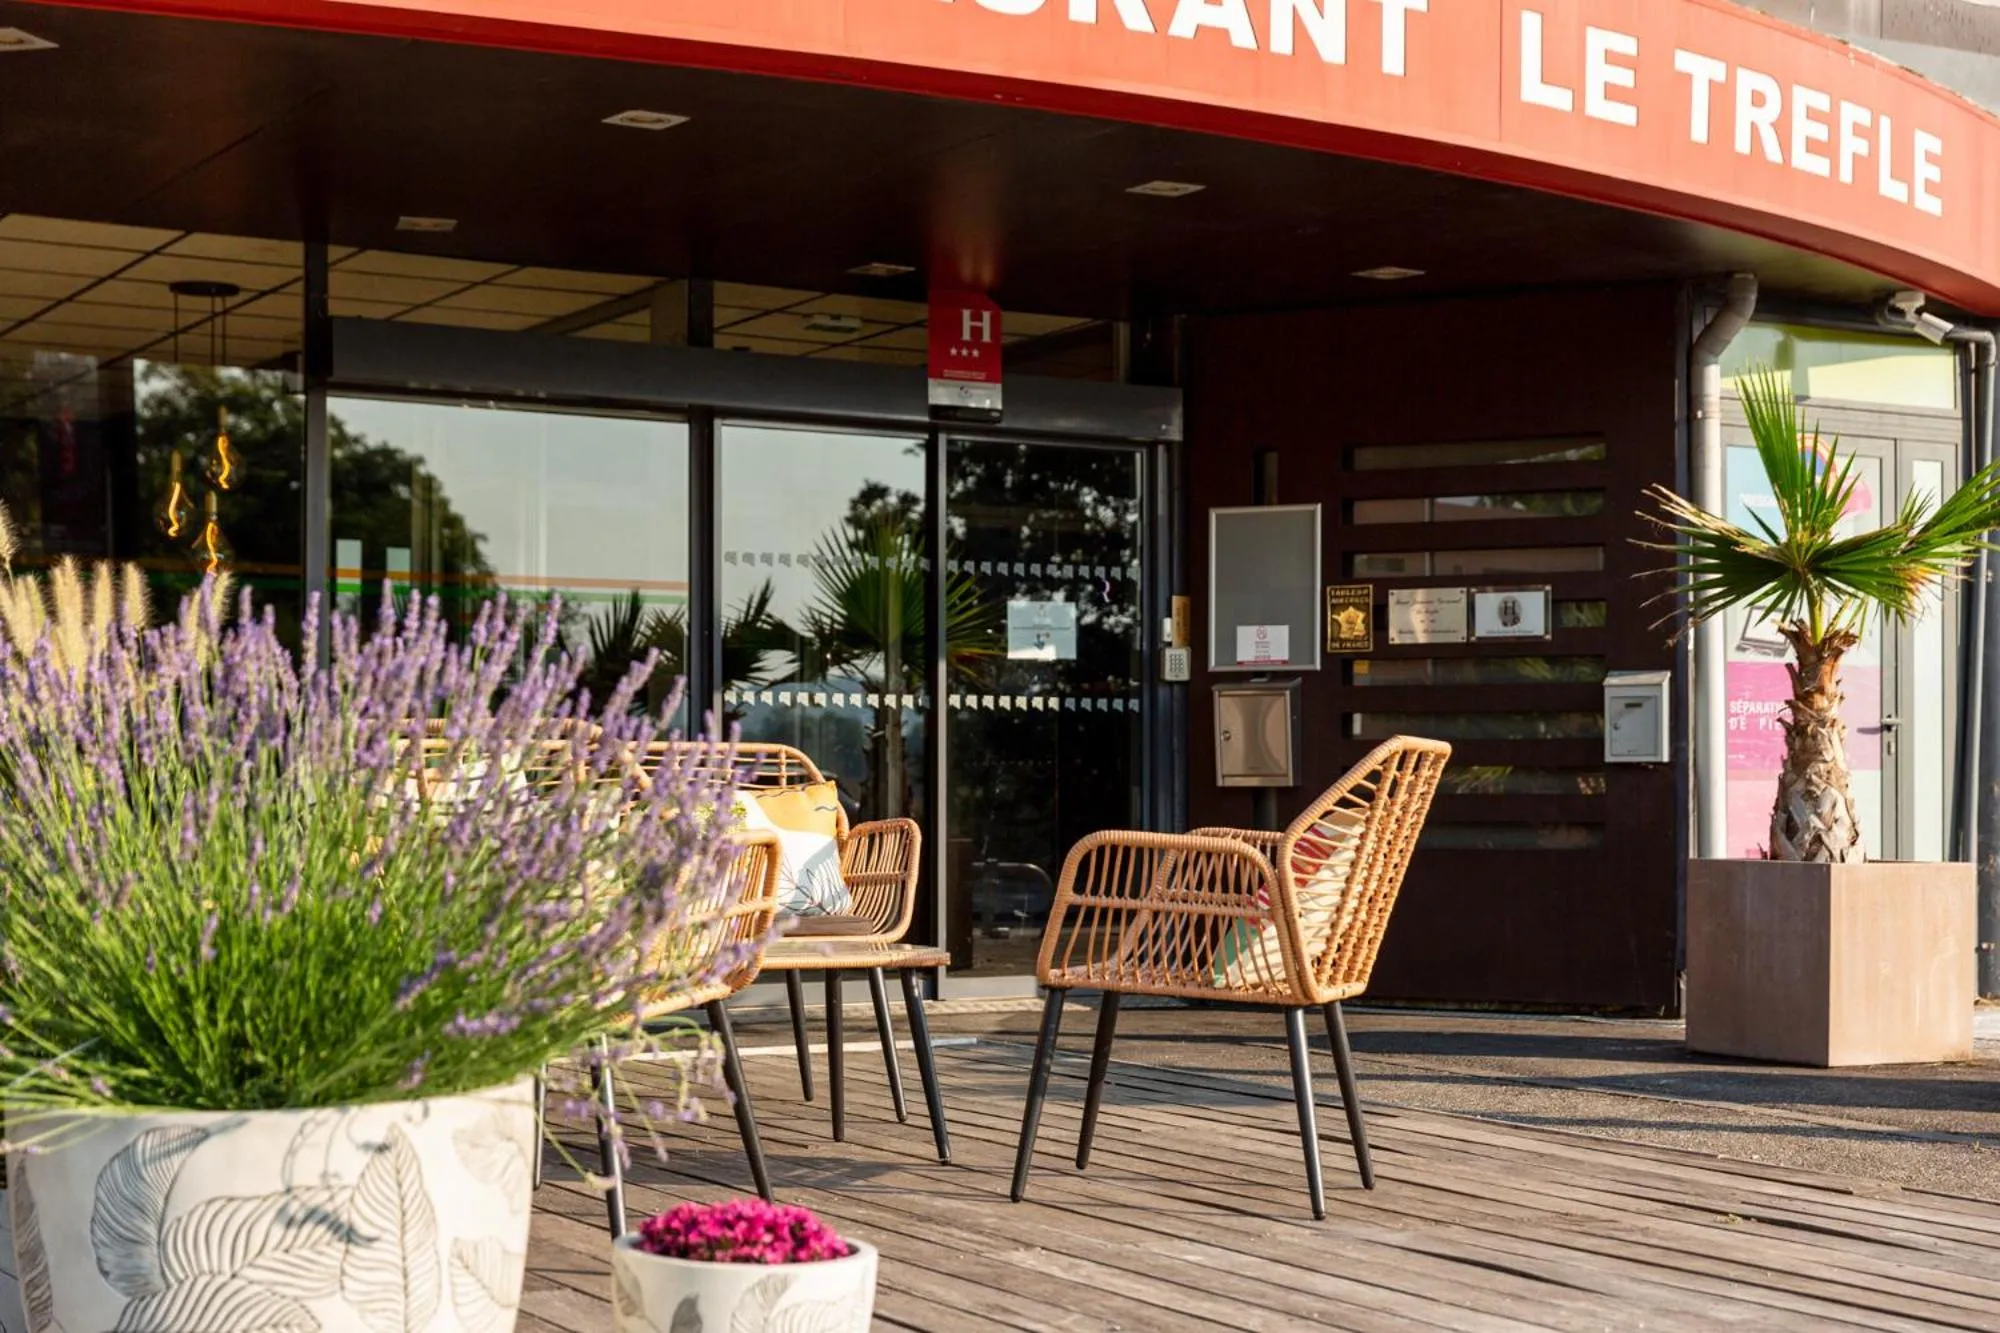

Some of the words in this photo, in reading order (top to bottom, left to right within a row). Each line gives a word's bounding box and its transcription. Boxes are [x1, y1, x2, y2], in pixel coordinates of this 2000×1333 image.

[976, 0, 1429, 77] ANT
[1520, 10, 1638, 128] LE
[1674, 48, 1943, 217] TREFLE
[961, 309, 992, 343] H
